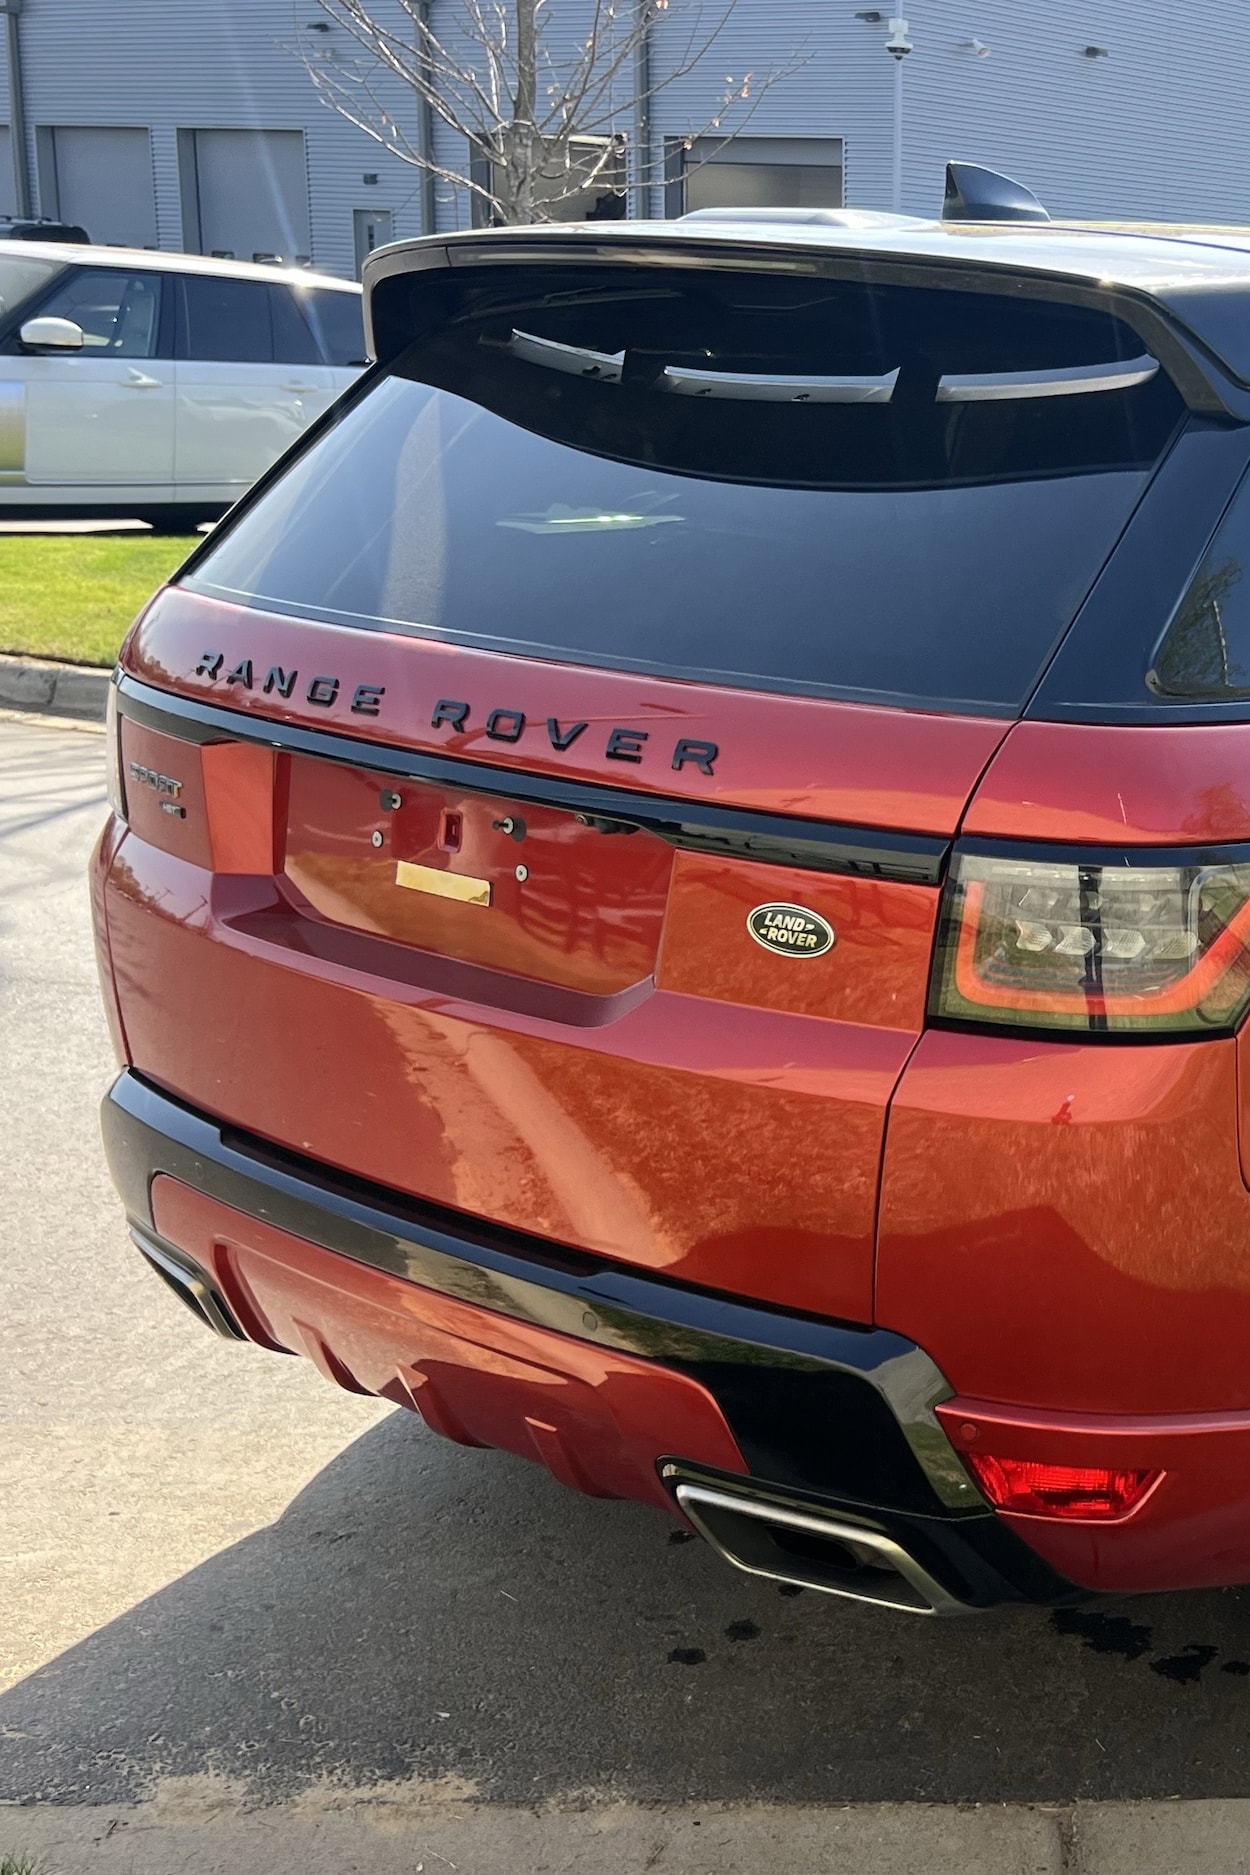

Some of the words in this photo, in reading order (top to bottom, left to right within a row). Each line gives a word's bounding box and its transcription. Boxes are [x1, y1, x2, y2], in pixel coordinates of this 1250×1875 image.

[196, 650, 386, 717] RANGE
[431, 699, 719, 776] ROVER
[130, 762, 182, 798] SPORT
[764, 912, 806, 931] LAND
[767, 927, 818, 948] ROVER
